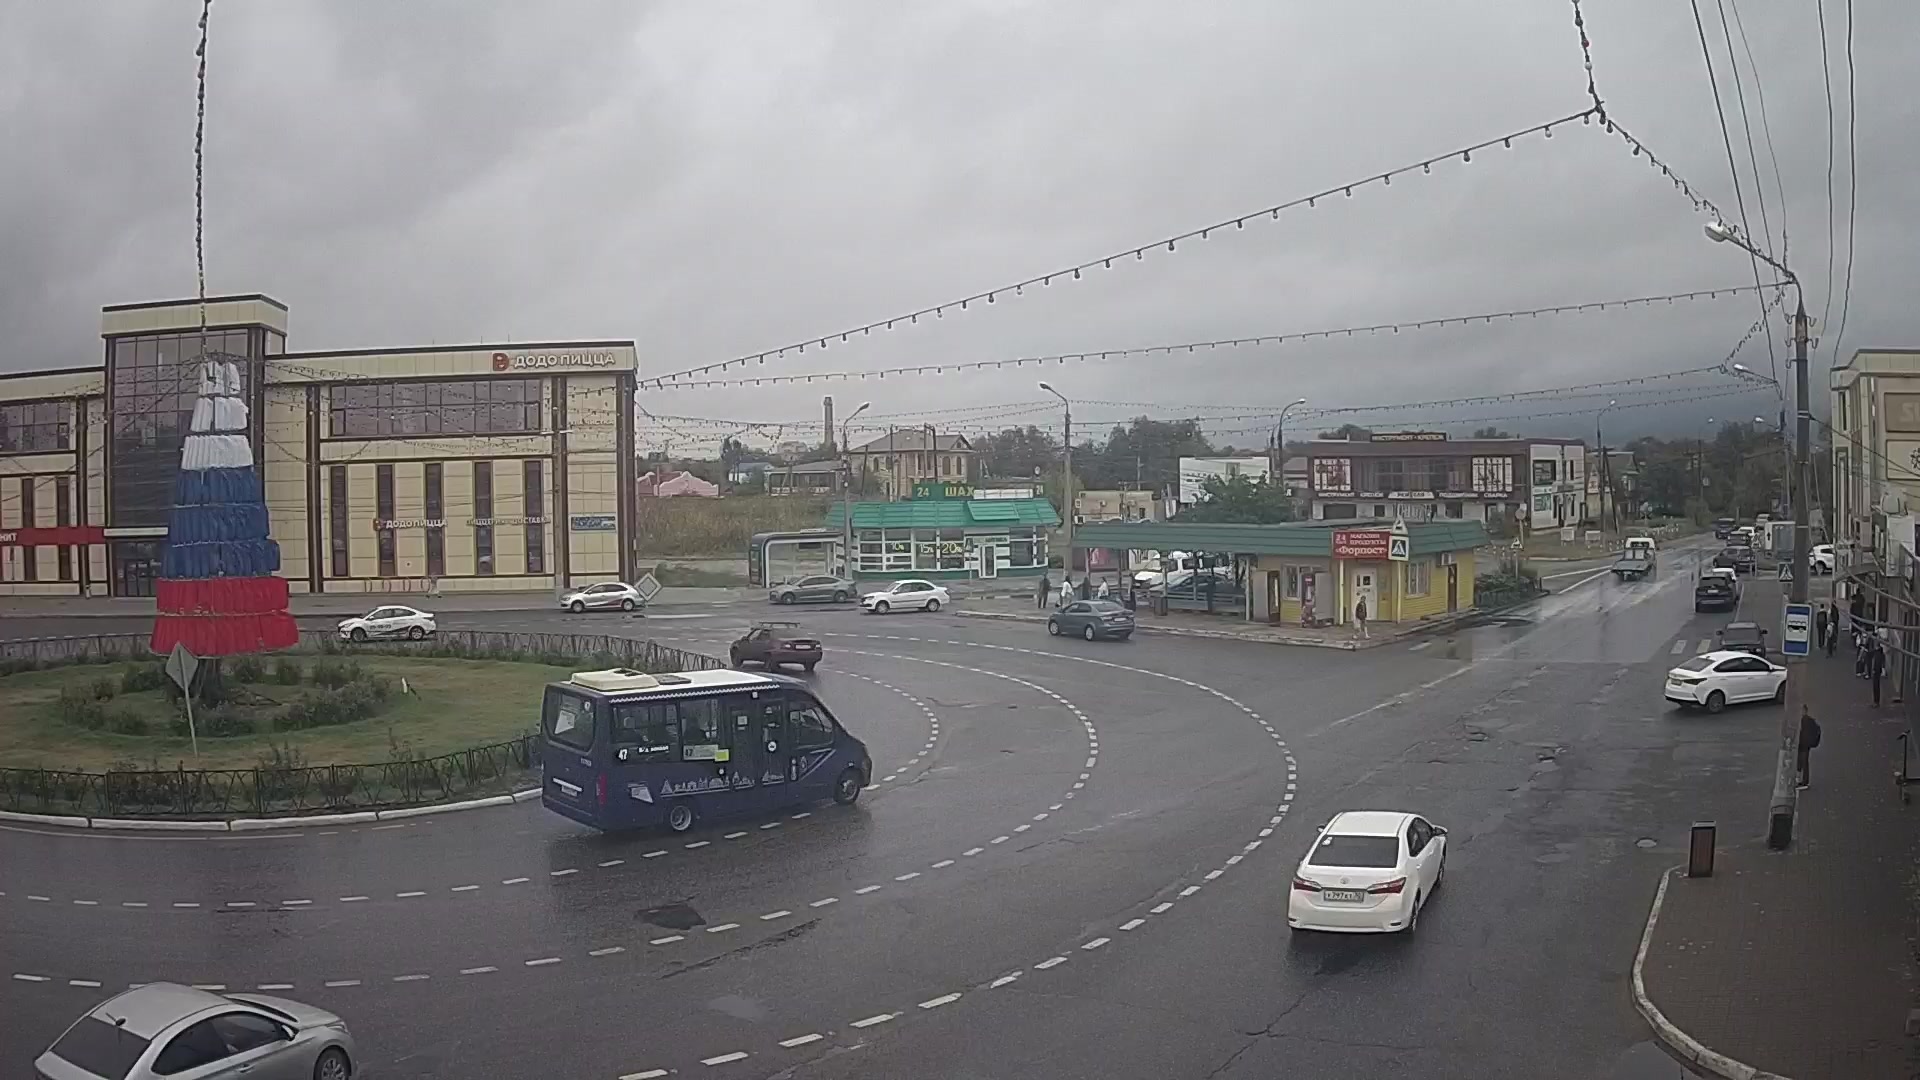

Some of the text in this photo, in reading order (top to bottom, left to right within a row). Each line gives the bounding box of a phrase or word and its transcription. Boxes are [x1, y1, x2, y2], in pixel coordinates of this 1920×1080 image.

[514, 352, 616, 368] ДОДО ПИЦЦА
[916, 487, 930, 498] 24
[385, 519, 413, 530] ДОДО
[1335, 546, 1388, 557] «Форпост»
